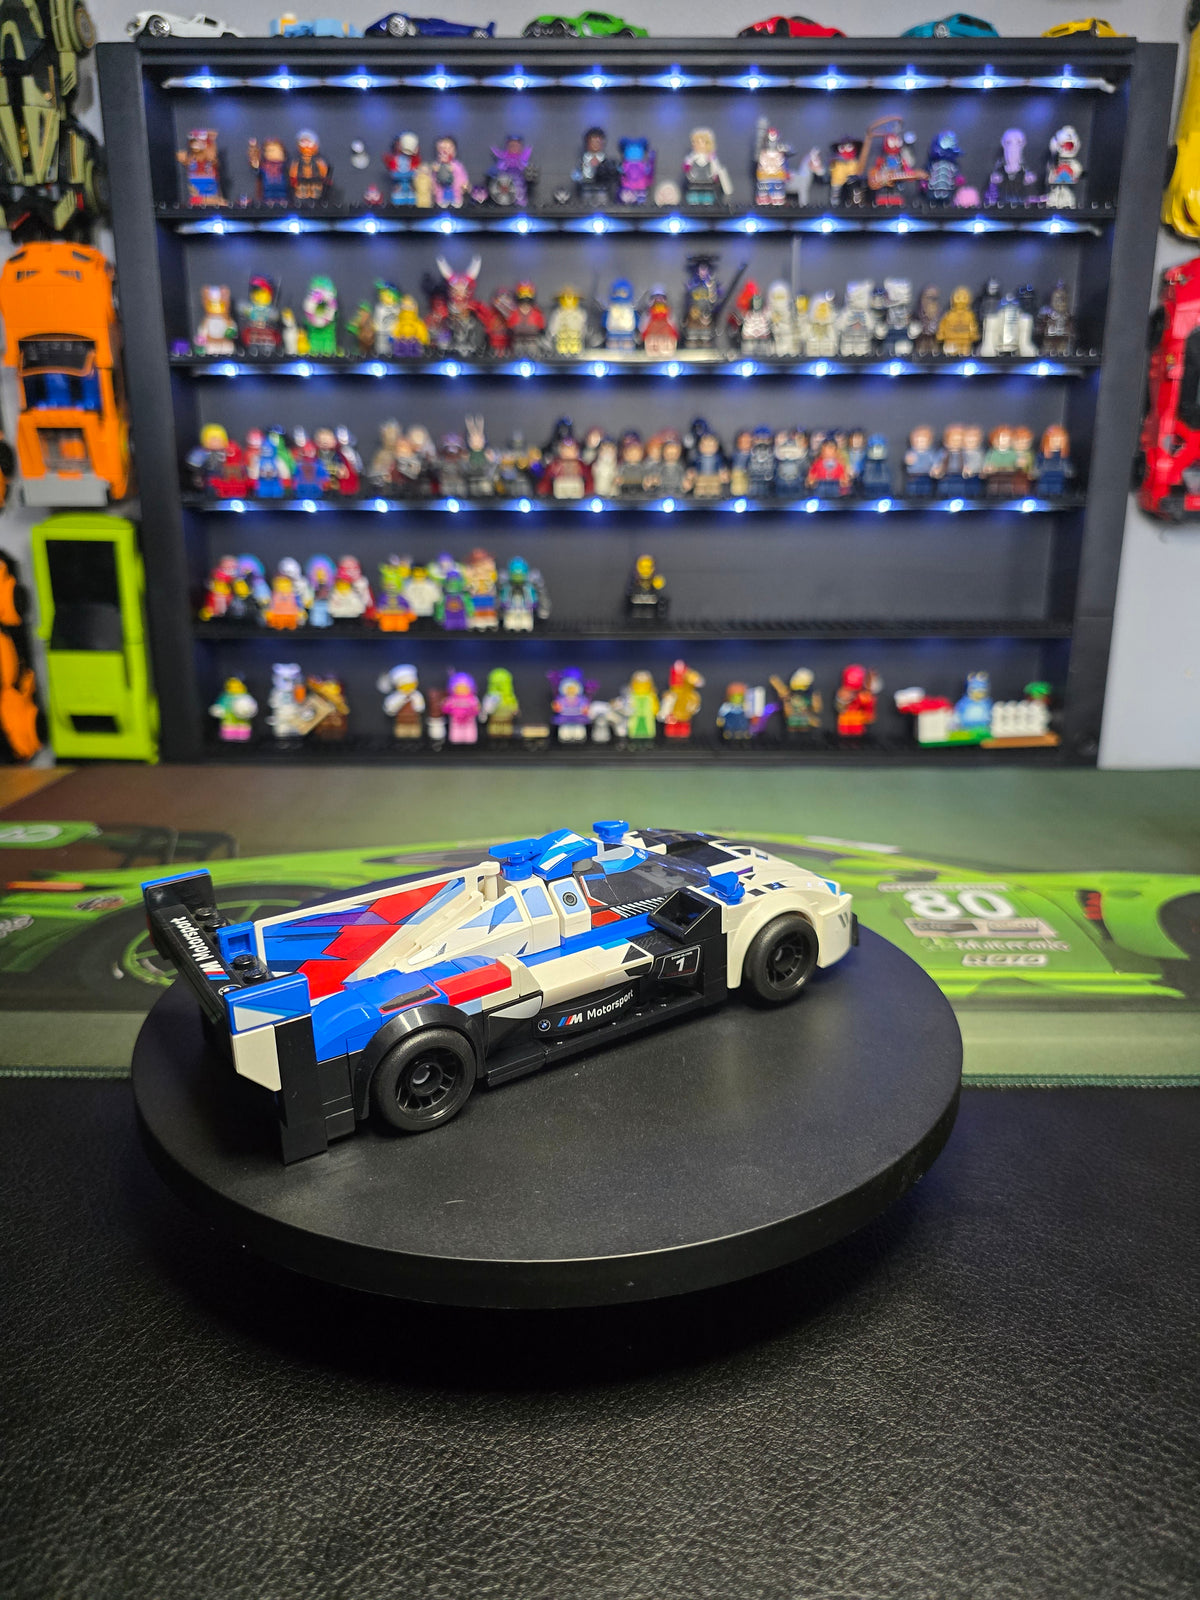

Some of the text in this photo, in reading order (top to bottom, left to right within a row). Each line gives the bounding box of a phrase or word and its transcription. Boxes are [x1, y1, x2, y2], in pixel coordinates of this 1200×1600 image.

[903, 890, 1015, 920] 80
[170, 916, 215, 961] Motorsport
[675, 956, 686, 972] 1
[587, 988, 634, 1020] Motorsport
